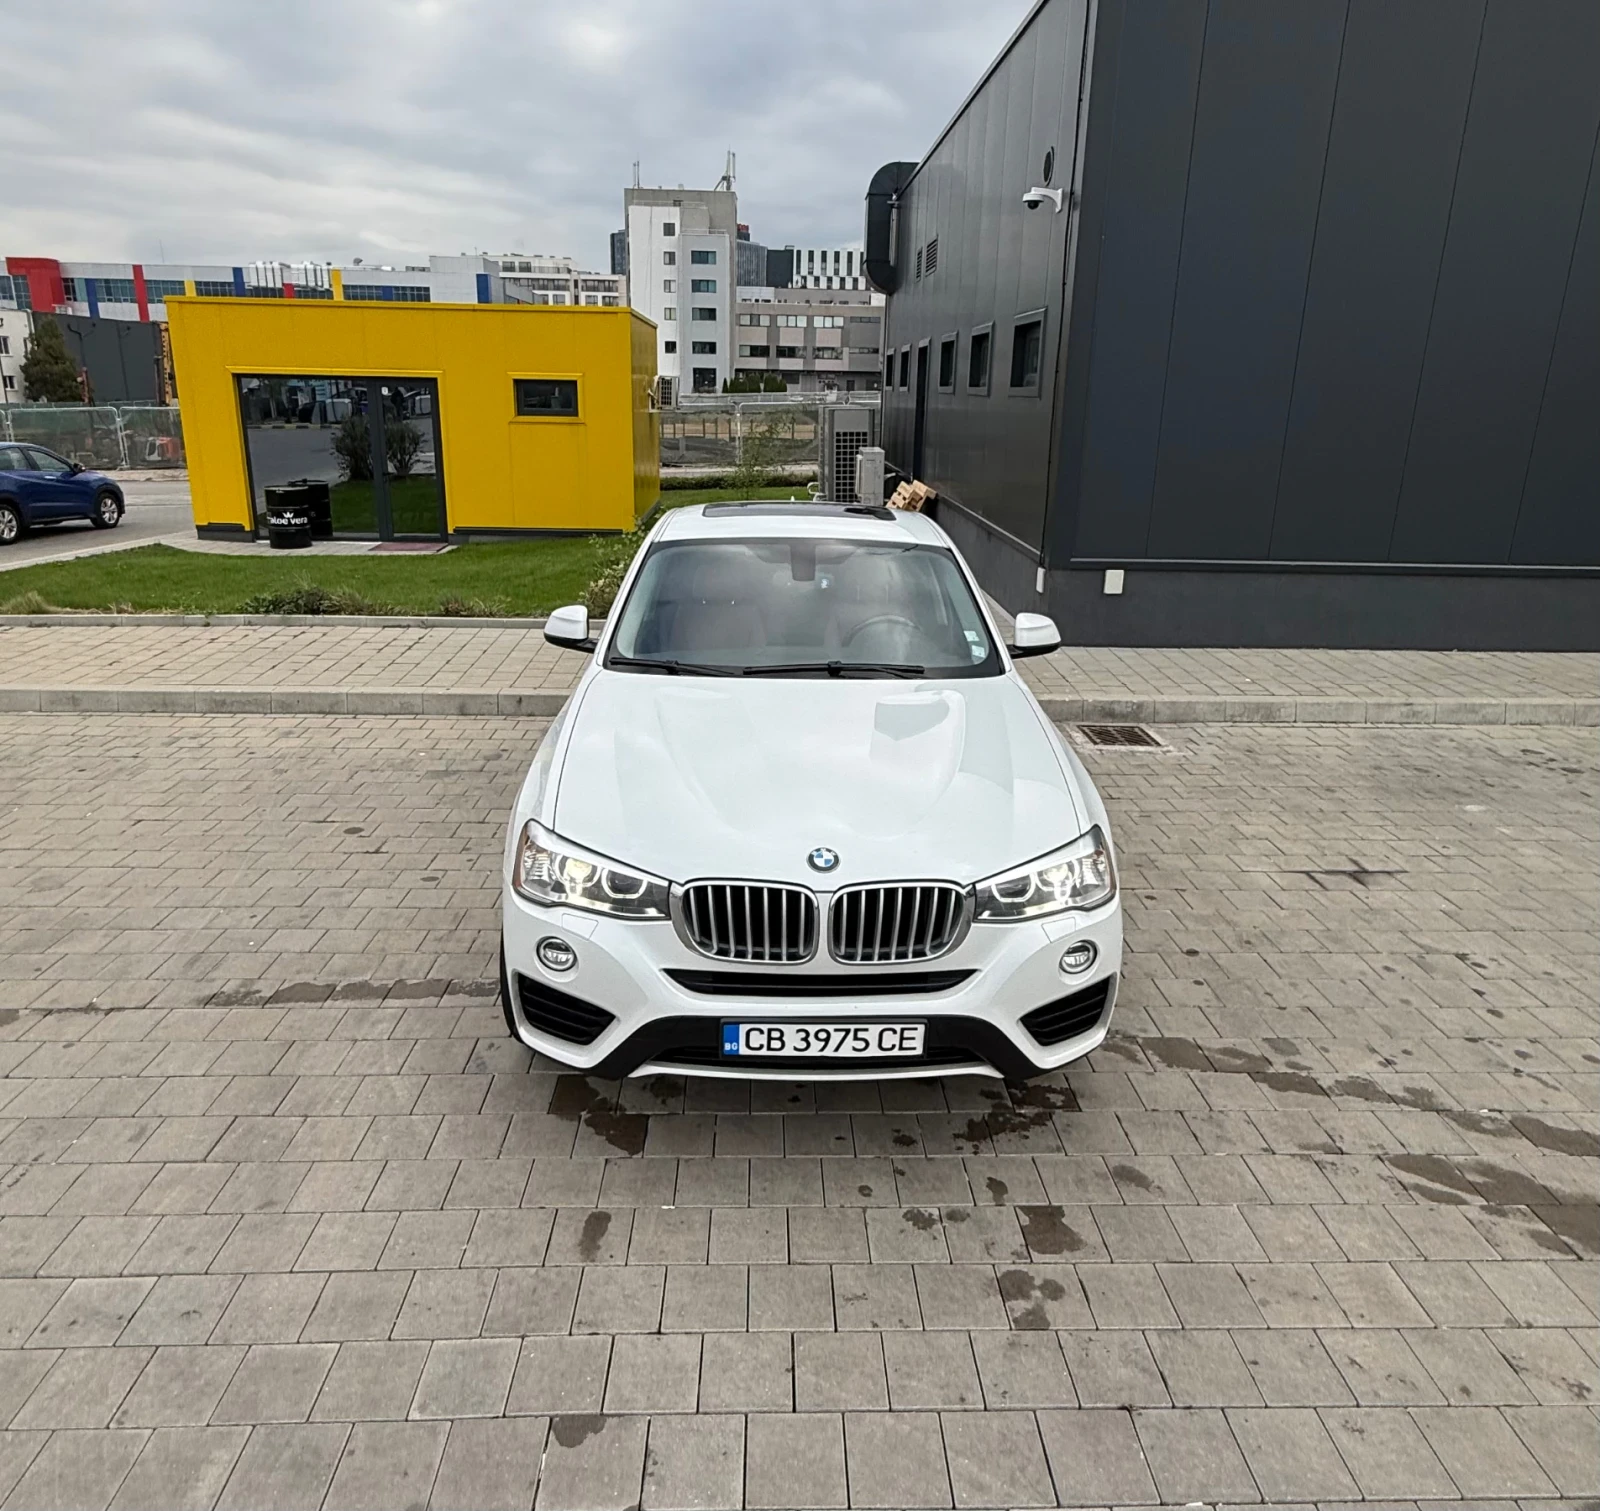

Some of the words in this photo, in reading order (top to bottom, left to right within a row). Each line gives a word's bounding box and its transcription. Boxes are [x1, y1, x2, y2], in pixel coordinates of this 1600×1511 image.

[724, 1042, 738, 1051] BG
[745, 1027, 786, 1051] CB
[792, 1028, 870, 1052] 3975
[877, 1027, 918, 1051] CE
